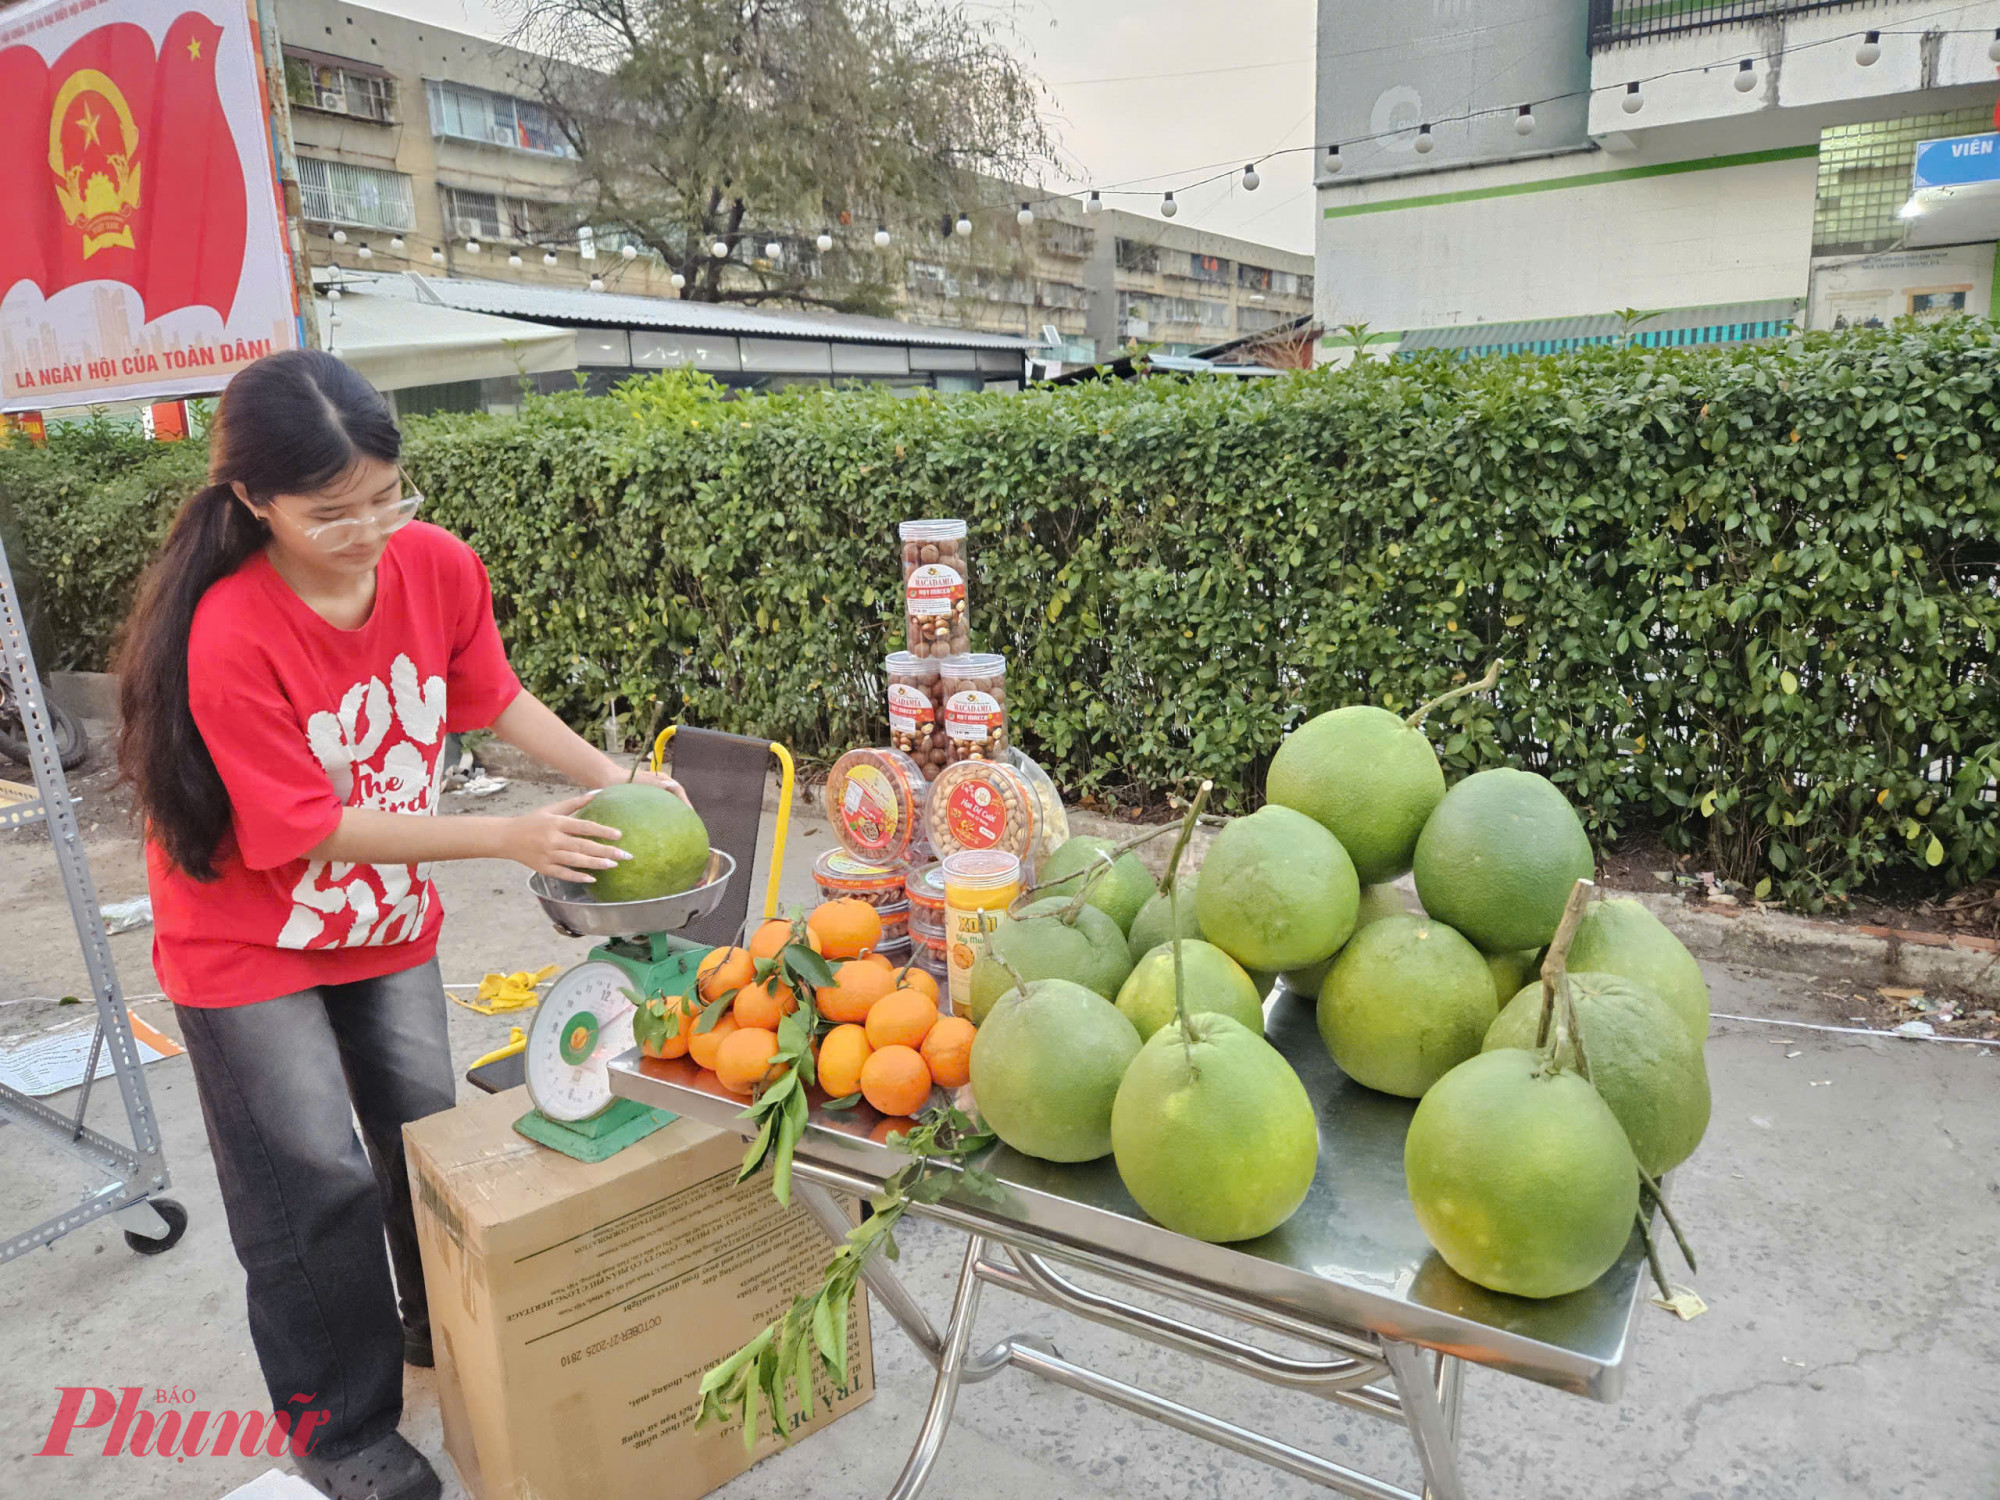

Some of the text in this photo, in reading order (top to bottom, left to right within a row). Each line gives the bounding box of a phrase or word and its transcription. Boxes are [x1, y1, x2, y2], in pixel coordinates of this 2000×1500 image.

[15, 338, 272, 389] LÀ NGÀY HỘI CỦA TOÀN DÂN!
[601, 989, 612, 1002] 12
[559, 1309, 662, 1370] OCTOBER-27-2025 2810
[820, 1371, 863, 1418] TRÀ
